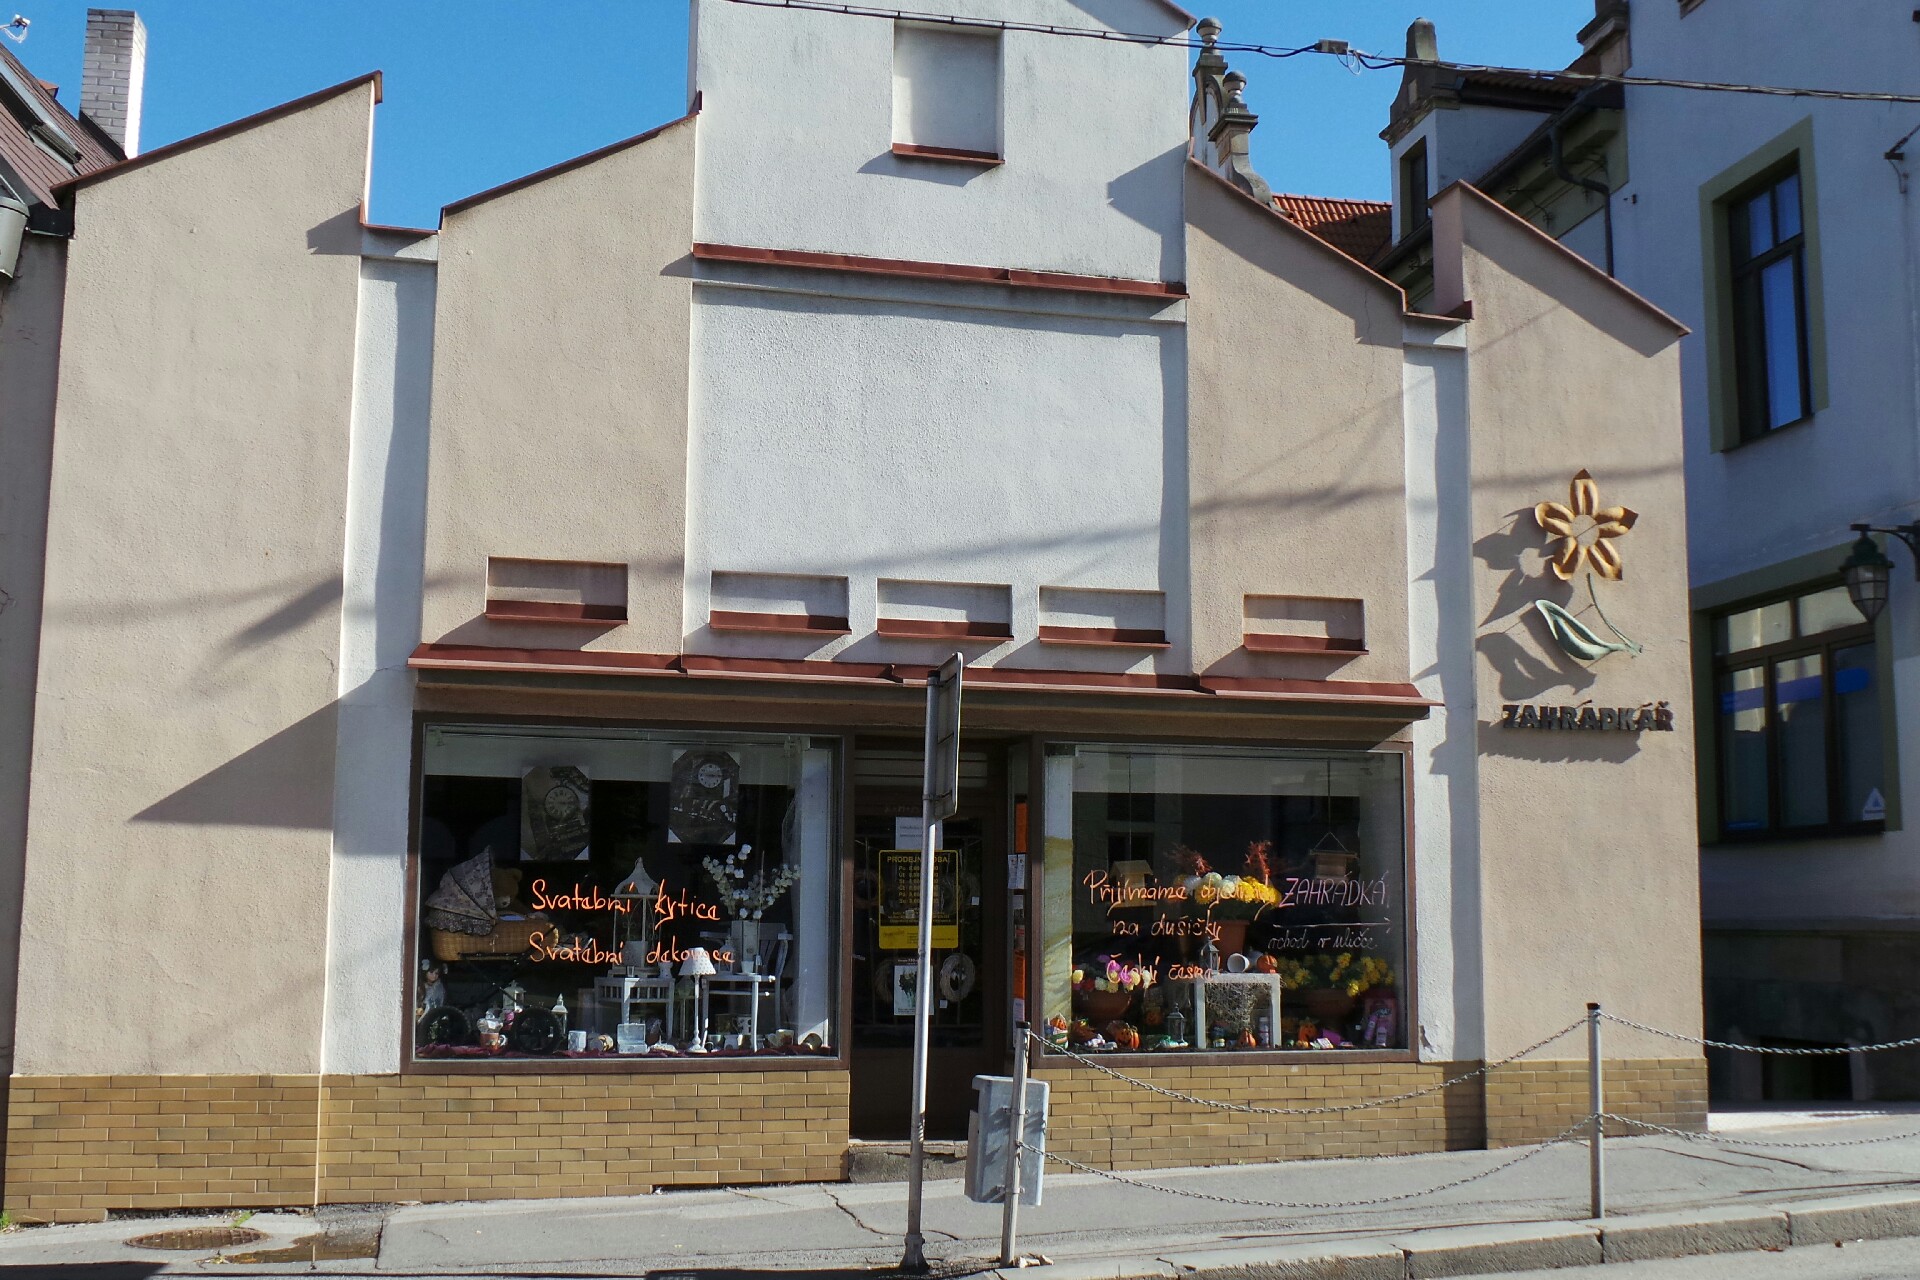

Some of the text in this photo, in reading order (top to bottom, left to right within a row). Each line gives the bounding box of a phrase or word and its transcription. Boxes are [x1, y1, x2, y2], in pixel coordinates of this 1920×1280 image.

[1502, 699, 1674, 732] ZAHRÁDKÁŘ
[531, 878, 720, 930] Svatební kytice
[1112, 908, 1222, 941] na dušičky
[529, 931, 624, 965] Svatební
[1317, 935, 1332, 949] v
